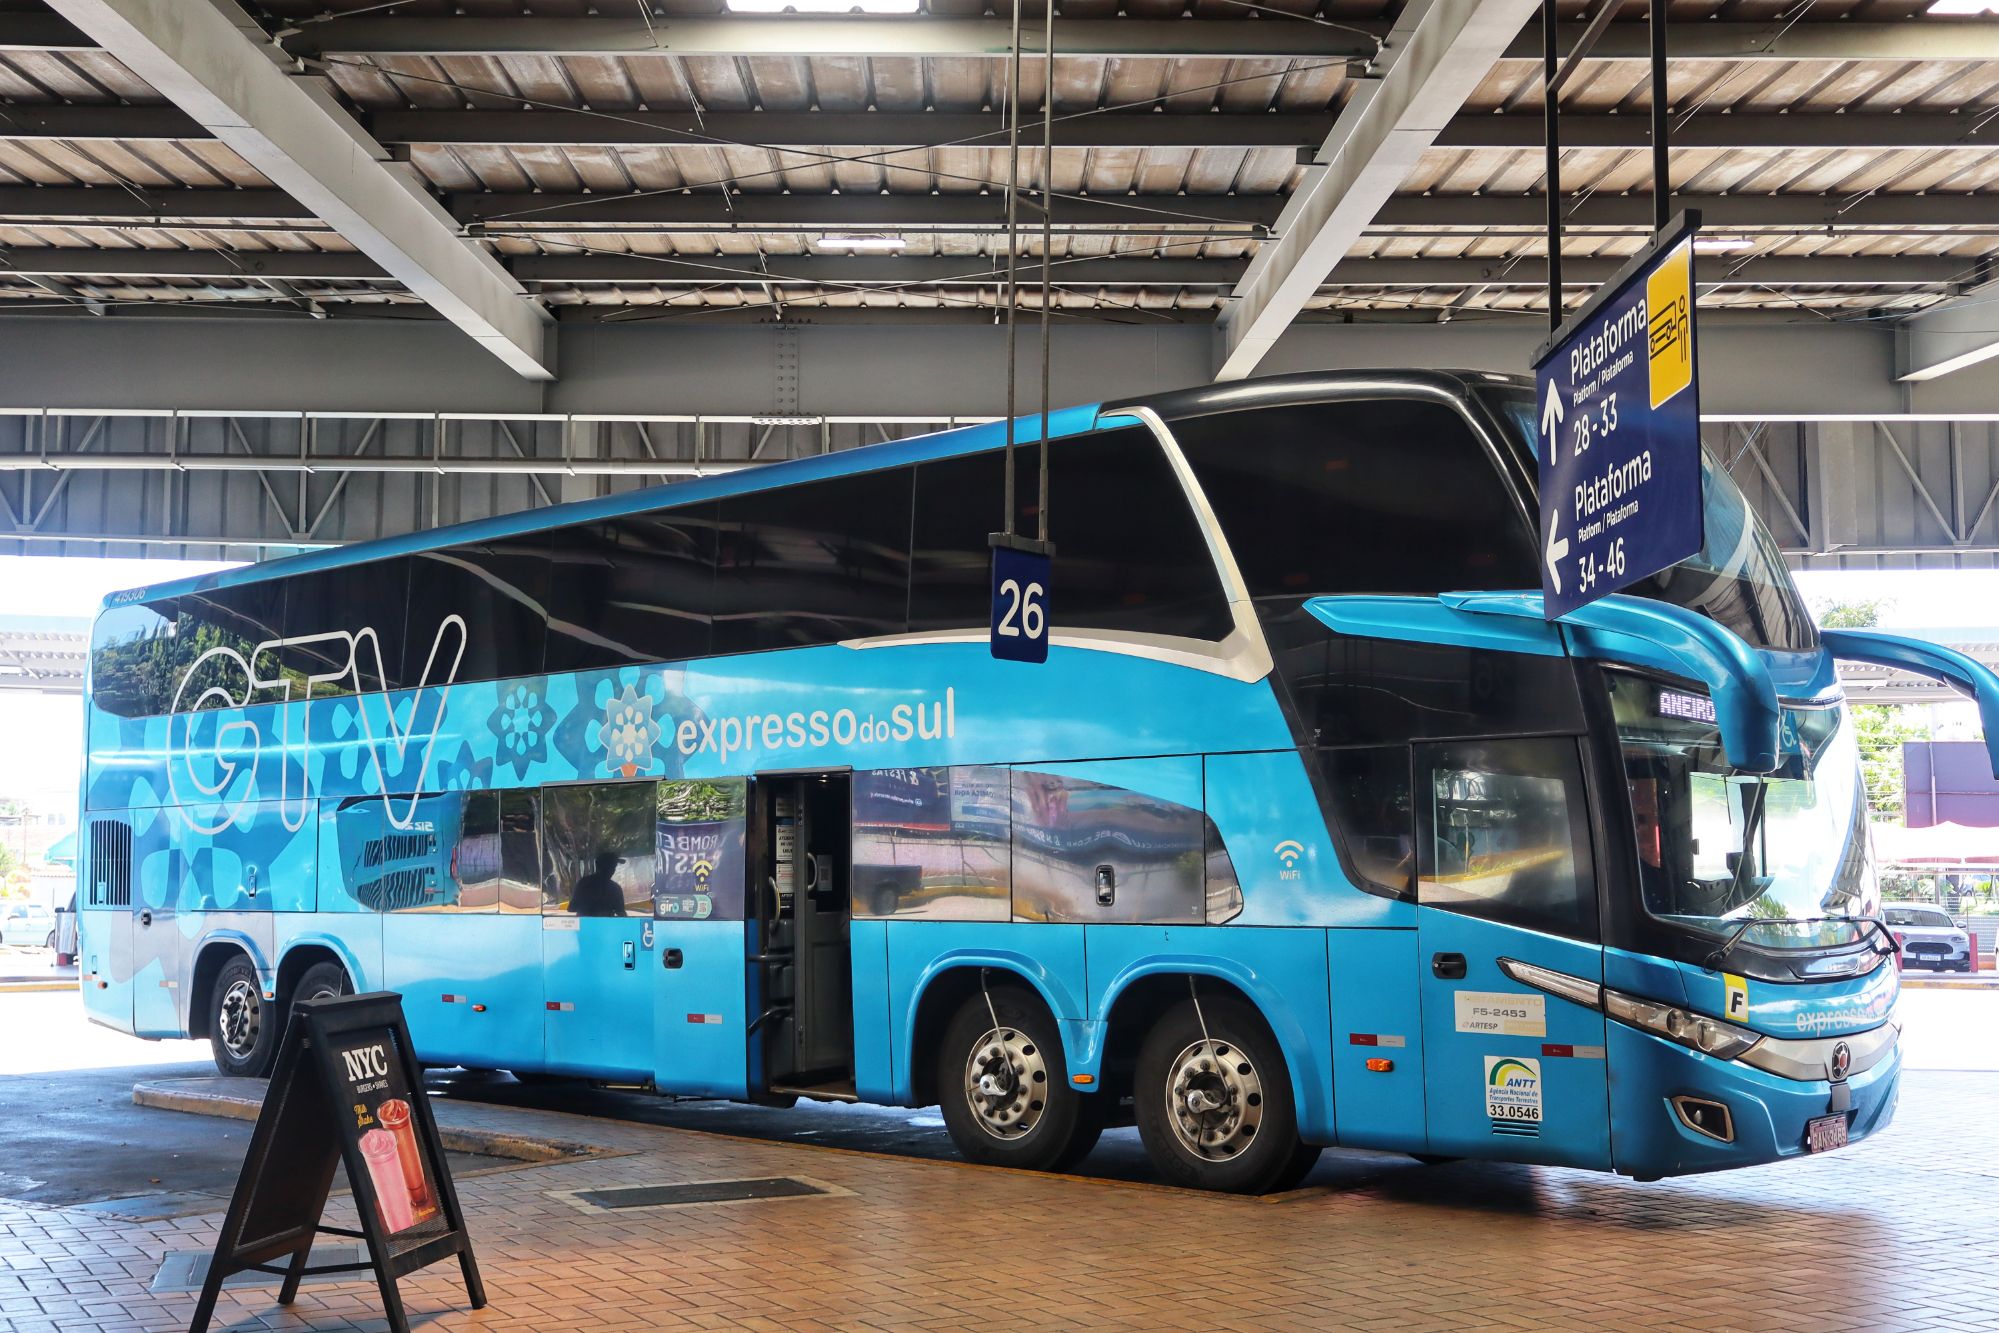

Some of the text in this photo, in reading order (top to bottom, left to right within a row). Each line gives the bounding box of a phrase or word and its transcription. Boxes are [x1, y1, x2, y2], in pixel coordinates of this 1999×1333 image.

[1571, 299, 1647, 385] Plataforma
[1573, 381, 1596, 407] Platform
[1601, 351, 1634, 384] Plataforma
[1573, 414, 1590, 457] 28
[1600, 392, 1618, 437] 33
[1575, 450, 1652, 521] Plataforma
[1578, 520, 1602, 543] Platform
[1606, 500, 1639, 529] Plataforma
[1578, 552, 1595, 593] 34
[1606, 536, 1626, 579] 46
[998, 579, 1044, 639] 26
[166, 615, 466, 834] GTV
[1280, 870, 1301, 880] WiFi
[660, 900, 680, 915] giro
[1473, 1007, 1527, 1018] F5-2453
[1730, 991, 1744, 1013] F
[1469, 1022, 1498, 1030] ARTESP
[342, 1045, 388, 1081] NYC
[1489, 1087, 1509, 1096] Agência
[1510, 1089, 1531, 1097] Nacional
[1506, 1078, 1536, 1089] ANTT
[1489, 1094, 1538, 1104] Transportes Terrestres
[1490, 1104, 1539, 1120] 33.0546
